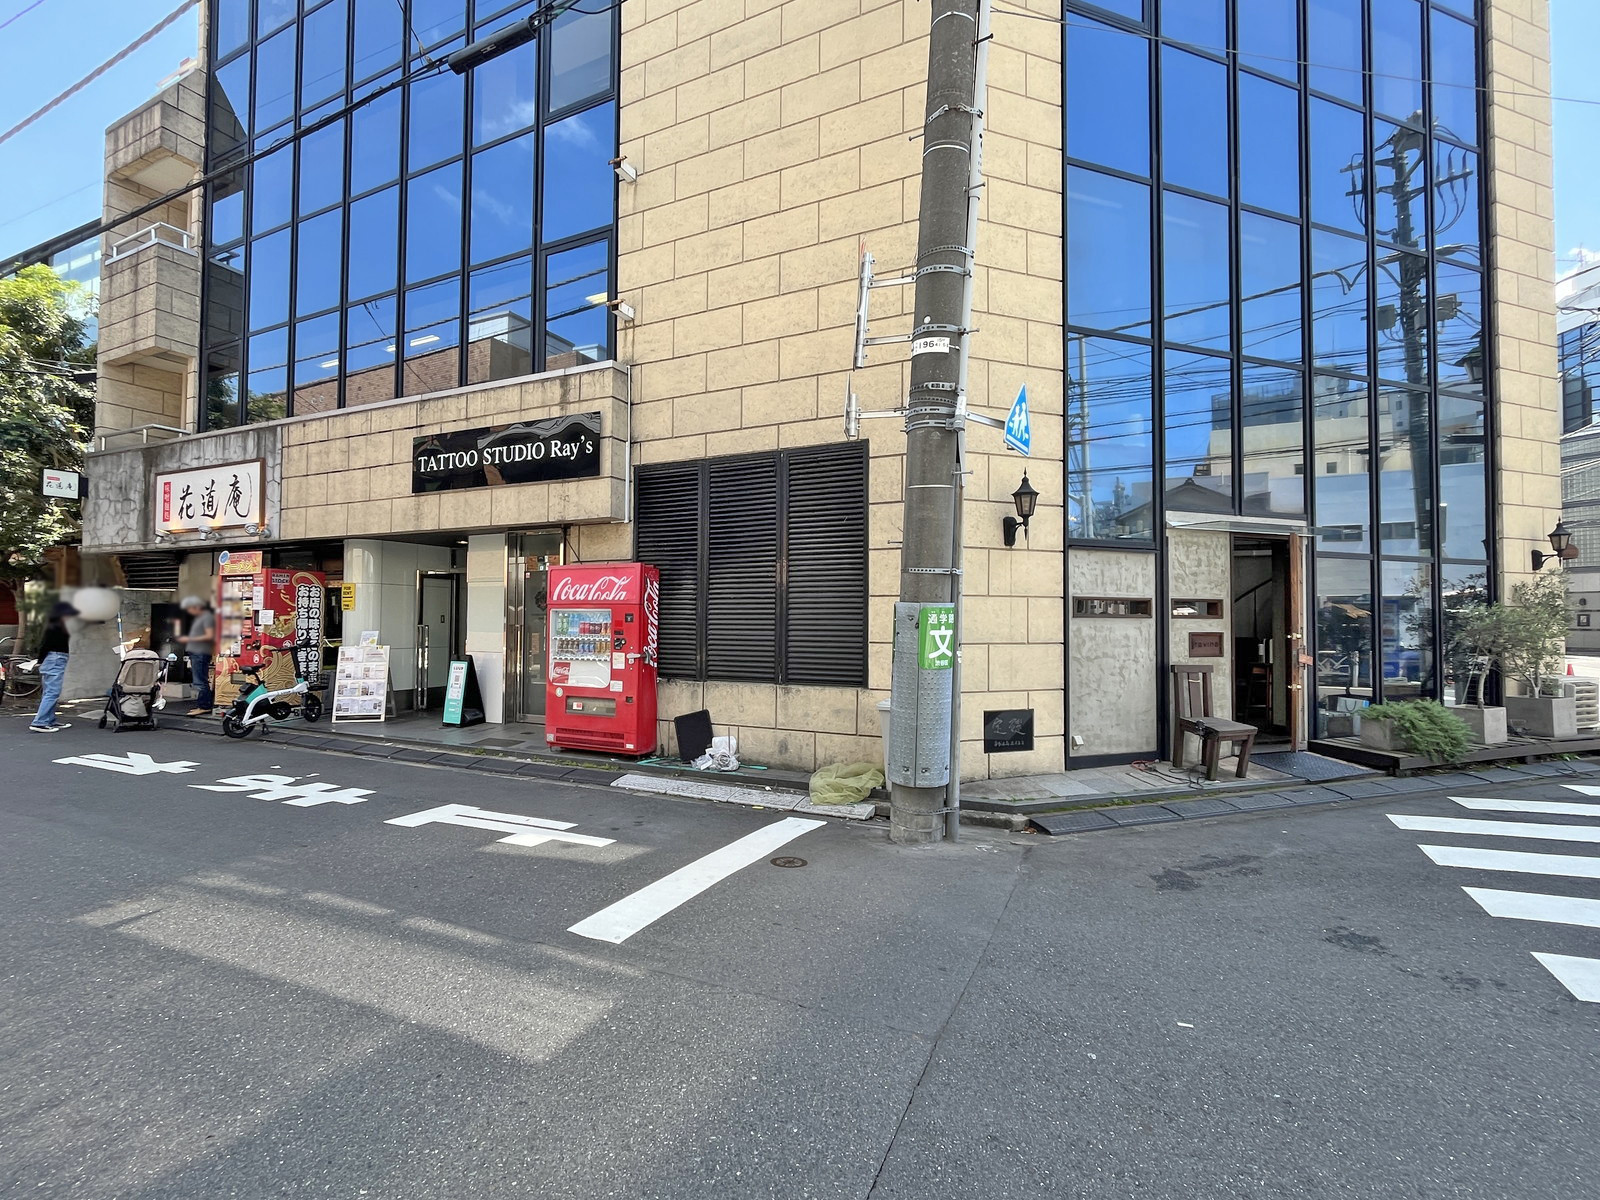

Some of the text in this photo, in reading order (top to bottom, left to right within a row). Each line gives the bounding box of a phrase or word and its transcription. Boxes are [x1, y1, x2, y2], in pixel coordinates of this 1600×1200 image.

[418, 435, 594, 473] TATTOO STUDIO Ray's
[178, 472, 252, 520] 花道庵
[552, 575, 634, 601] Coca-Cola
[928, 625, 954, 659] 文
